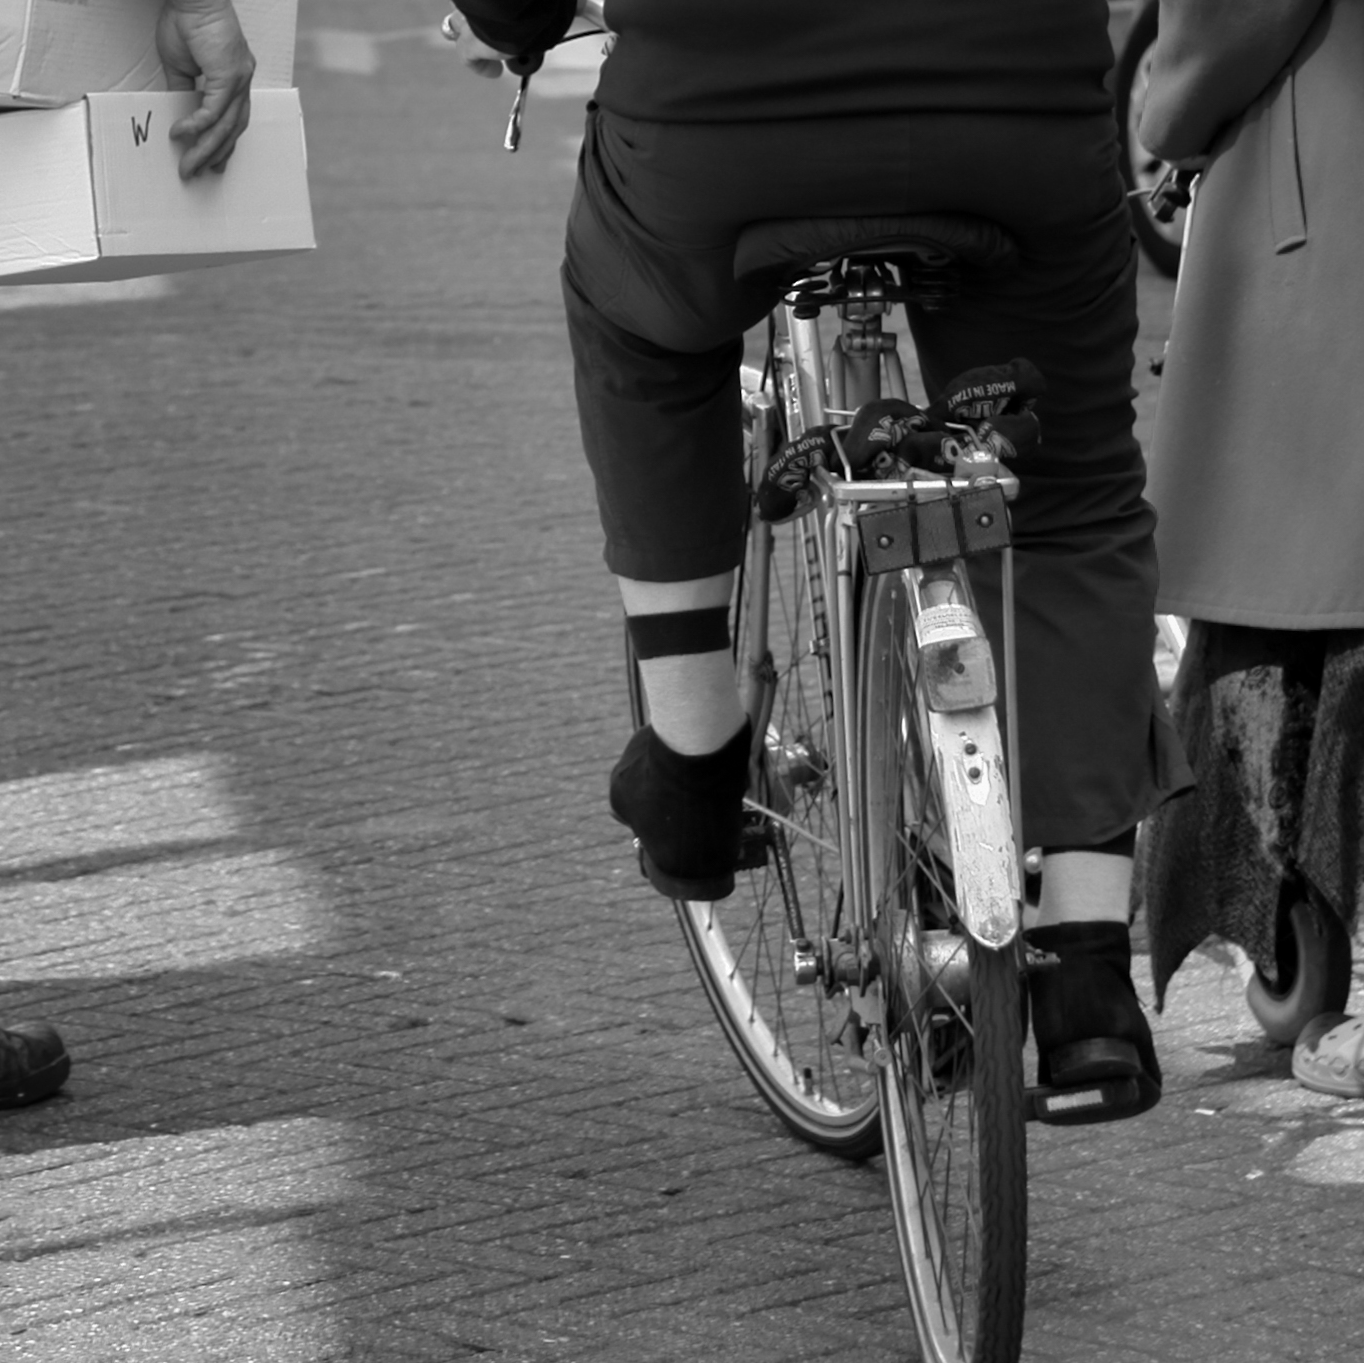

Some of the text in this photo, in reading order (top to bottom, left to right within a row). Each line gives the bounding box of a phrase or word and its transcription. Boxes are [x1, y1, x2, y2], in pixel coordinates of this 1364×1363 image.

[973, 384, 986, 398] IN
[986, 380, 1017, 396] MADE
[947, 387, 973, 412] ITALY
[767, 436, 826, 482] MADE IN ITALY
